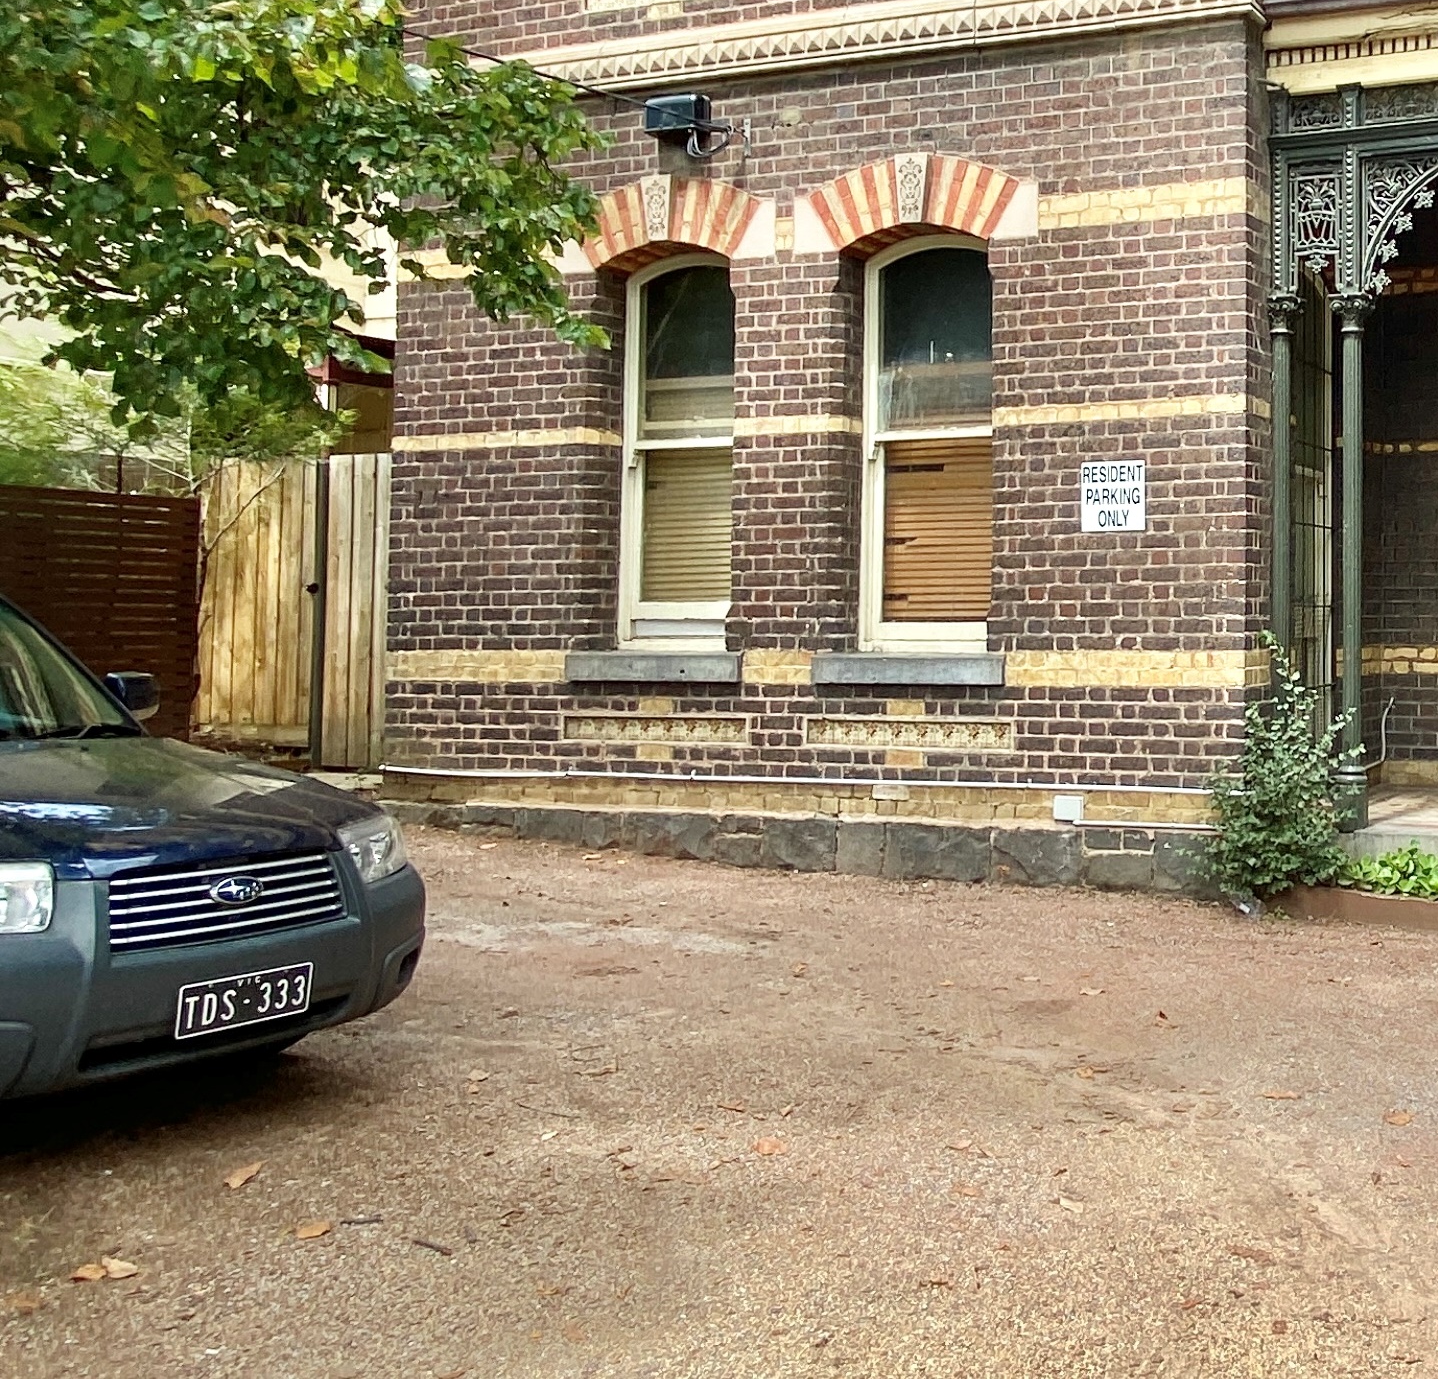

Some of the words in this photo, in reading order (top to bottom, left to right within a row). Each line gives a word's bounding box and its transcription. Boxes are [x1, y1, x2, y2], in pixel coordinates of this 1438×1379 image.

[1082, 465, 1143, 483] RESIDENT
[1086, 487, 1141, 505] PARKING
[1098, 509, 1129, 527] ONLY
[237, 975, 262, 987] VIC
